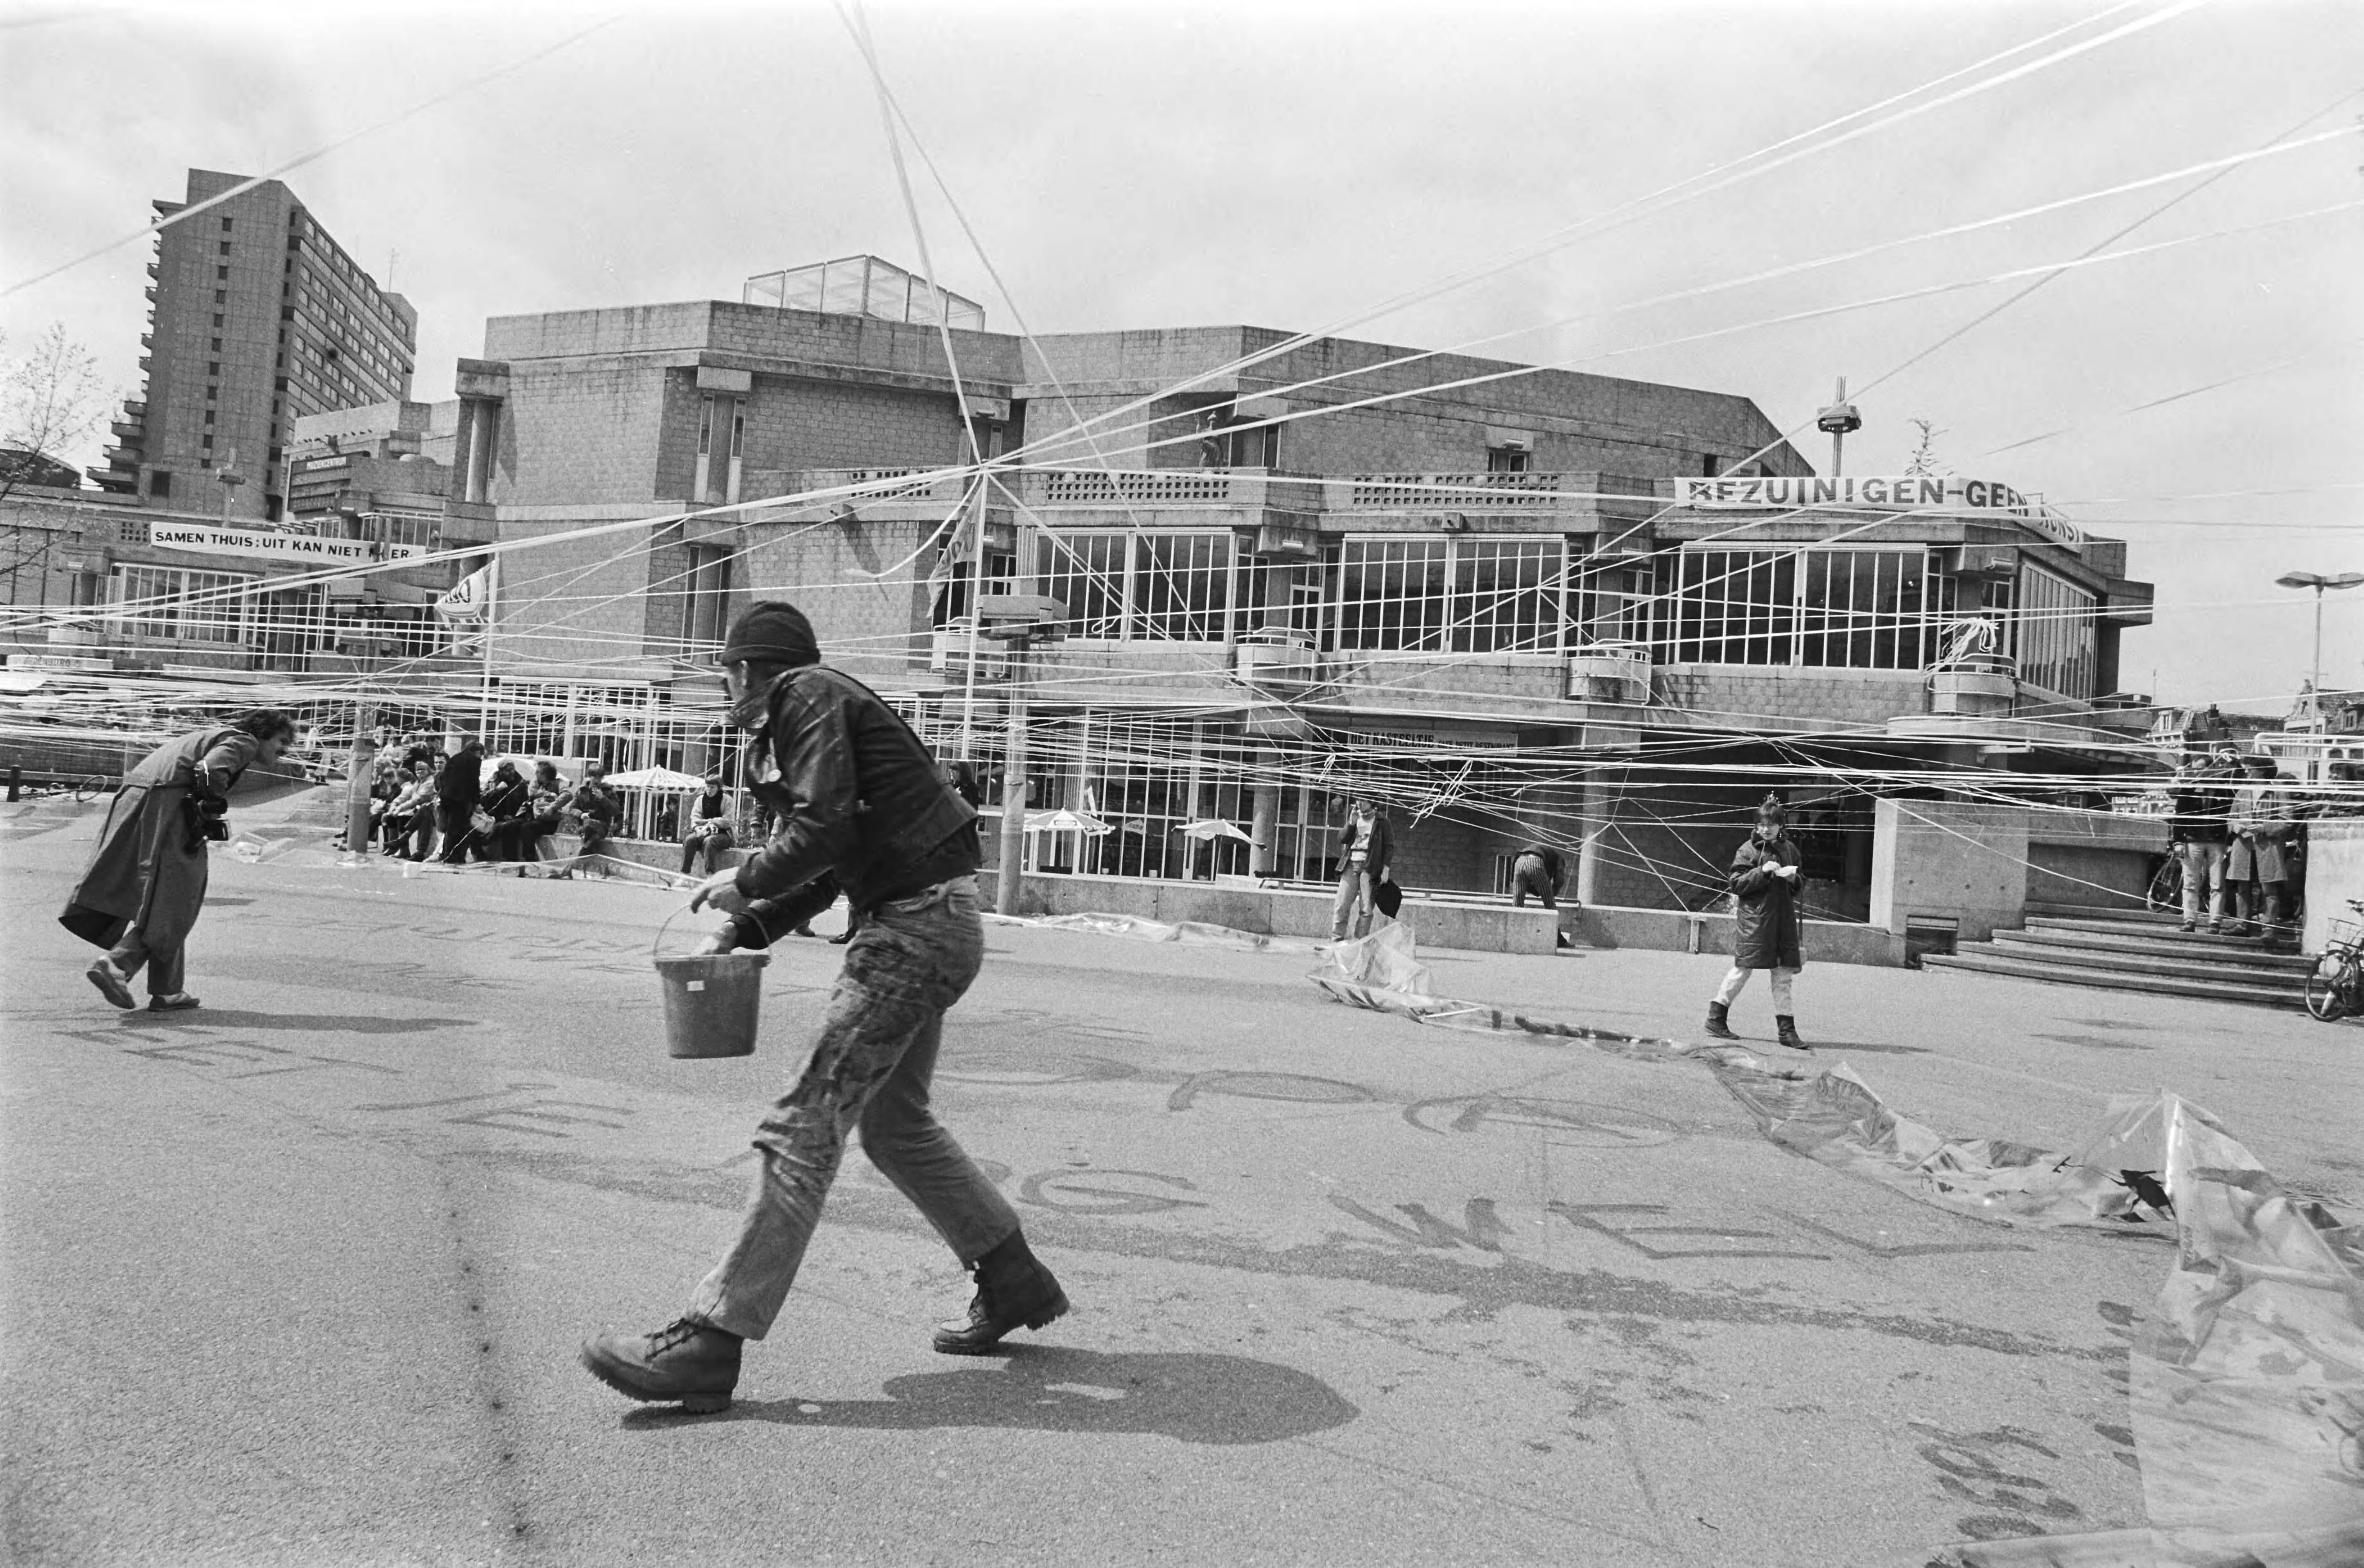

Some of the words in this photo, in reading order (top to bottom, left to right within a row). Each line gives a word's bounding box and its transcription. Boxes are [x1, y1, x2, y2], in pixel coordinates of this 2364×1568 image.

[155, 532, 205, 543] SAMEN
[292, 539, 321, 553] KAN
[328, 544, 362, 557] NIET
